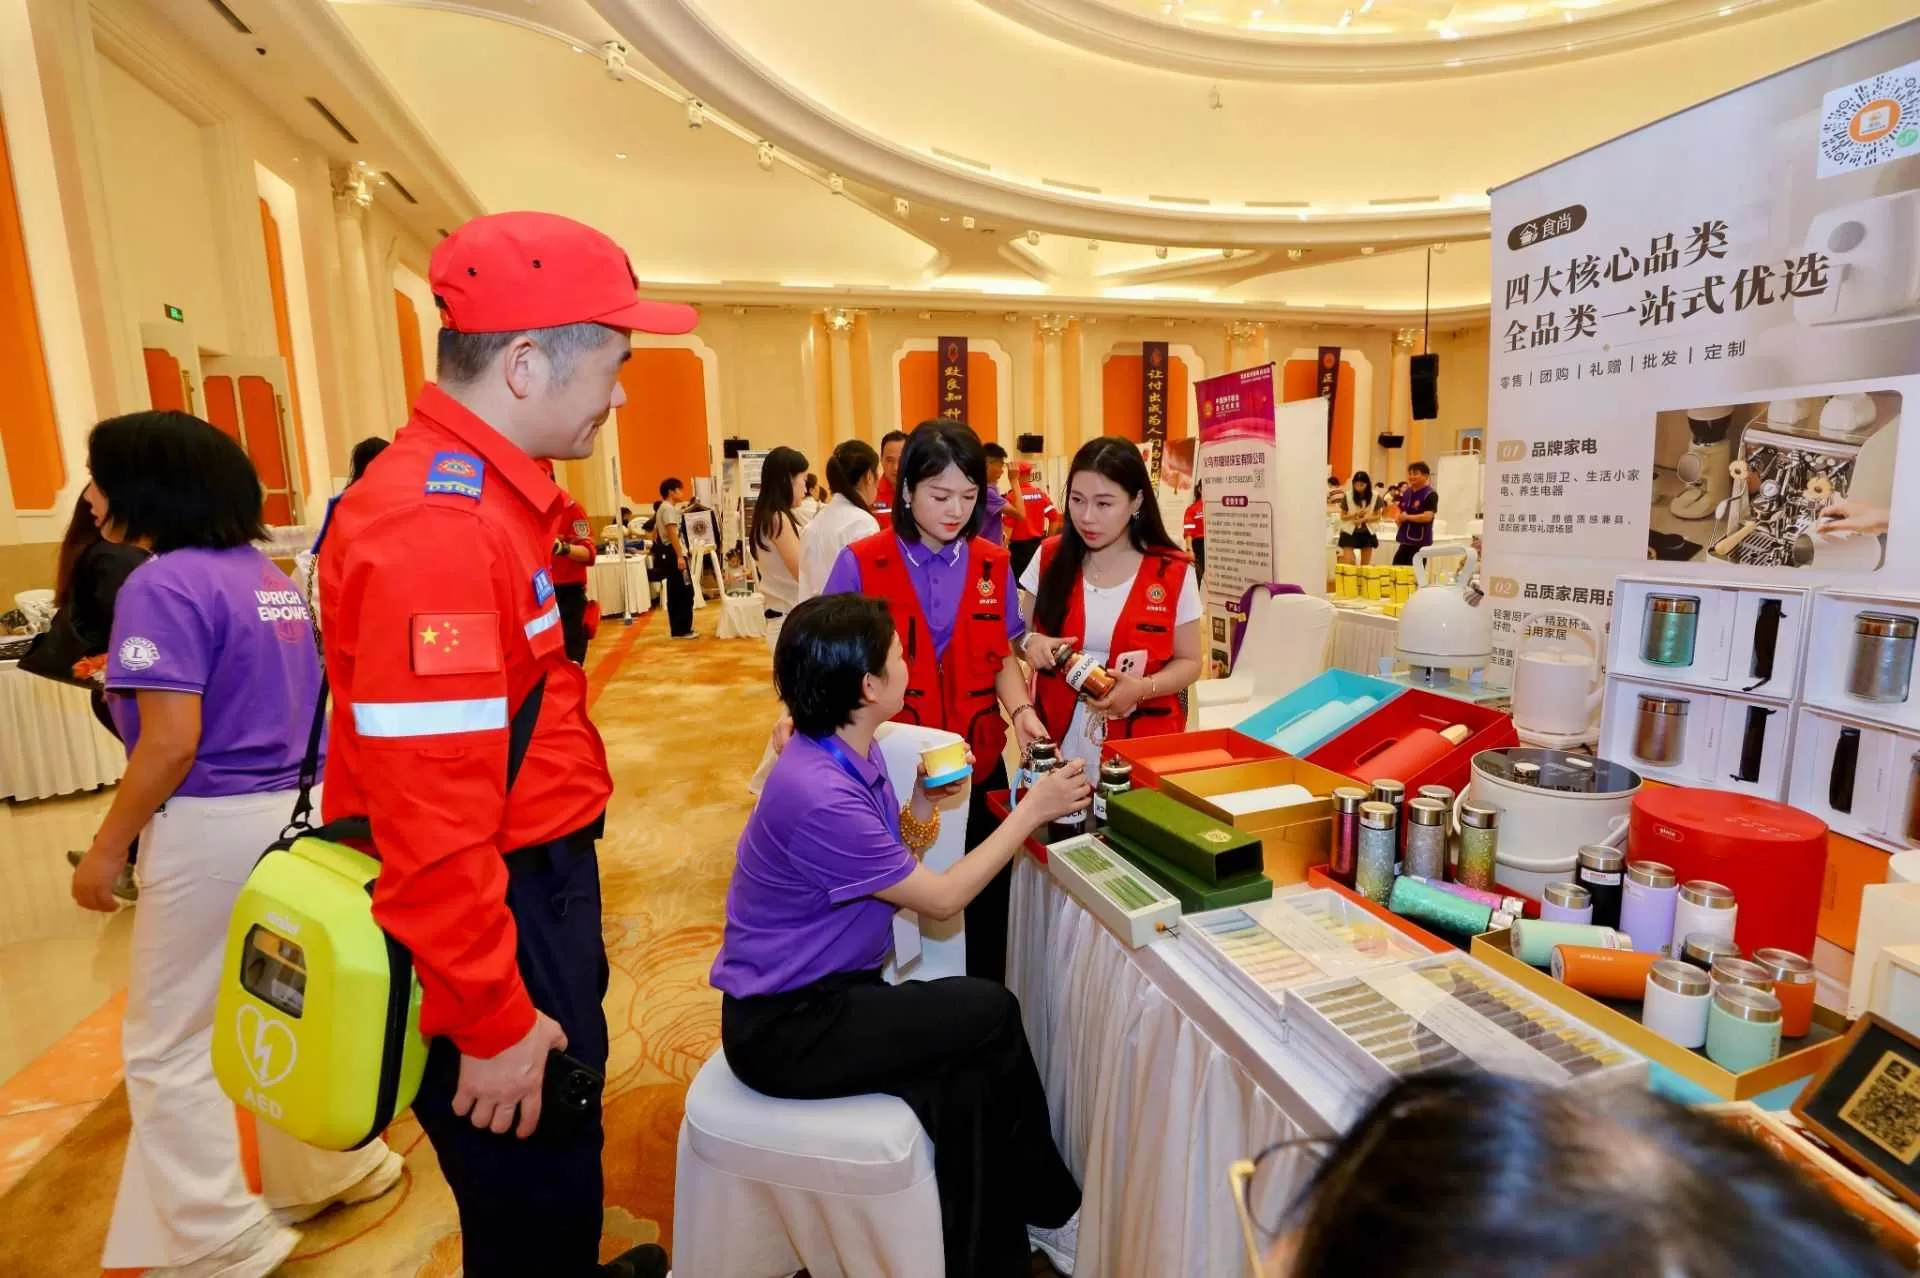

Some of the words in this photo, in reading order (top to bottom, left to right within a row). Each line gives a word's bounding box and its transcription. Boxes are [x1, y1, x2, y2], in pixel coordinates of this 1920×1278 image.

[1542, 212, 1572, 238] 食尚
[1505, 220, 1729, 310] 四大核心品类
[1503, 252, 1829, 355] 全品类一站式优选
[1500, 374, 1523, 389] 零售
[1540, 367, 1569, 384] 团购
[1590, 359, 1622, 377] 礼赠
[1642, 351, 1678, 370] 批发
[1704, 339, 1746, 361] 定制
[1503, 444, 1519, 457] 01
[1531, 438, 1598, 457] 品牌家电
[1495, 582, 1511, 594] 02
[1493, 608, 1592, 631] 轻奢厨、精致杯壶
[244, 1087, 283, 1120] AED
